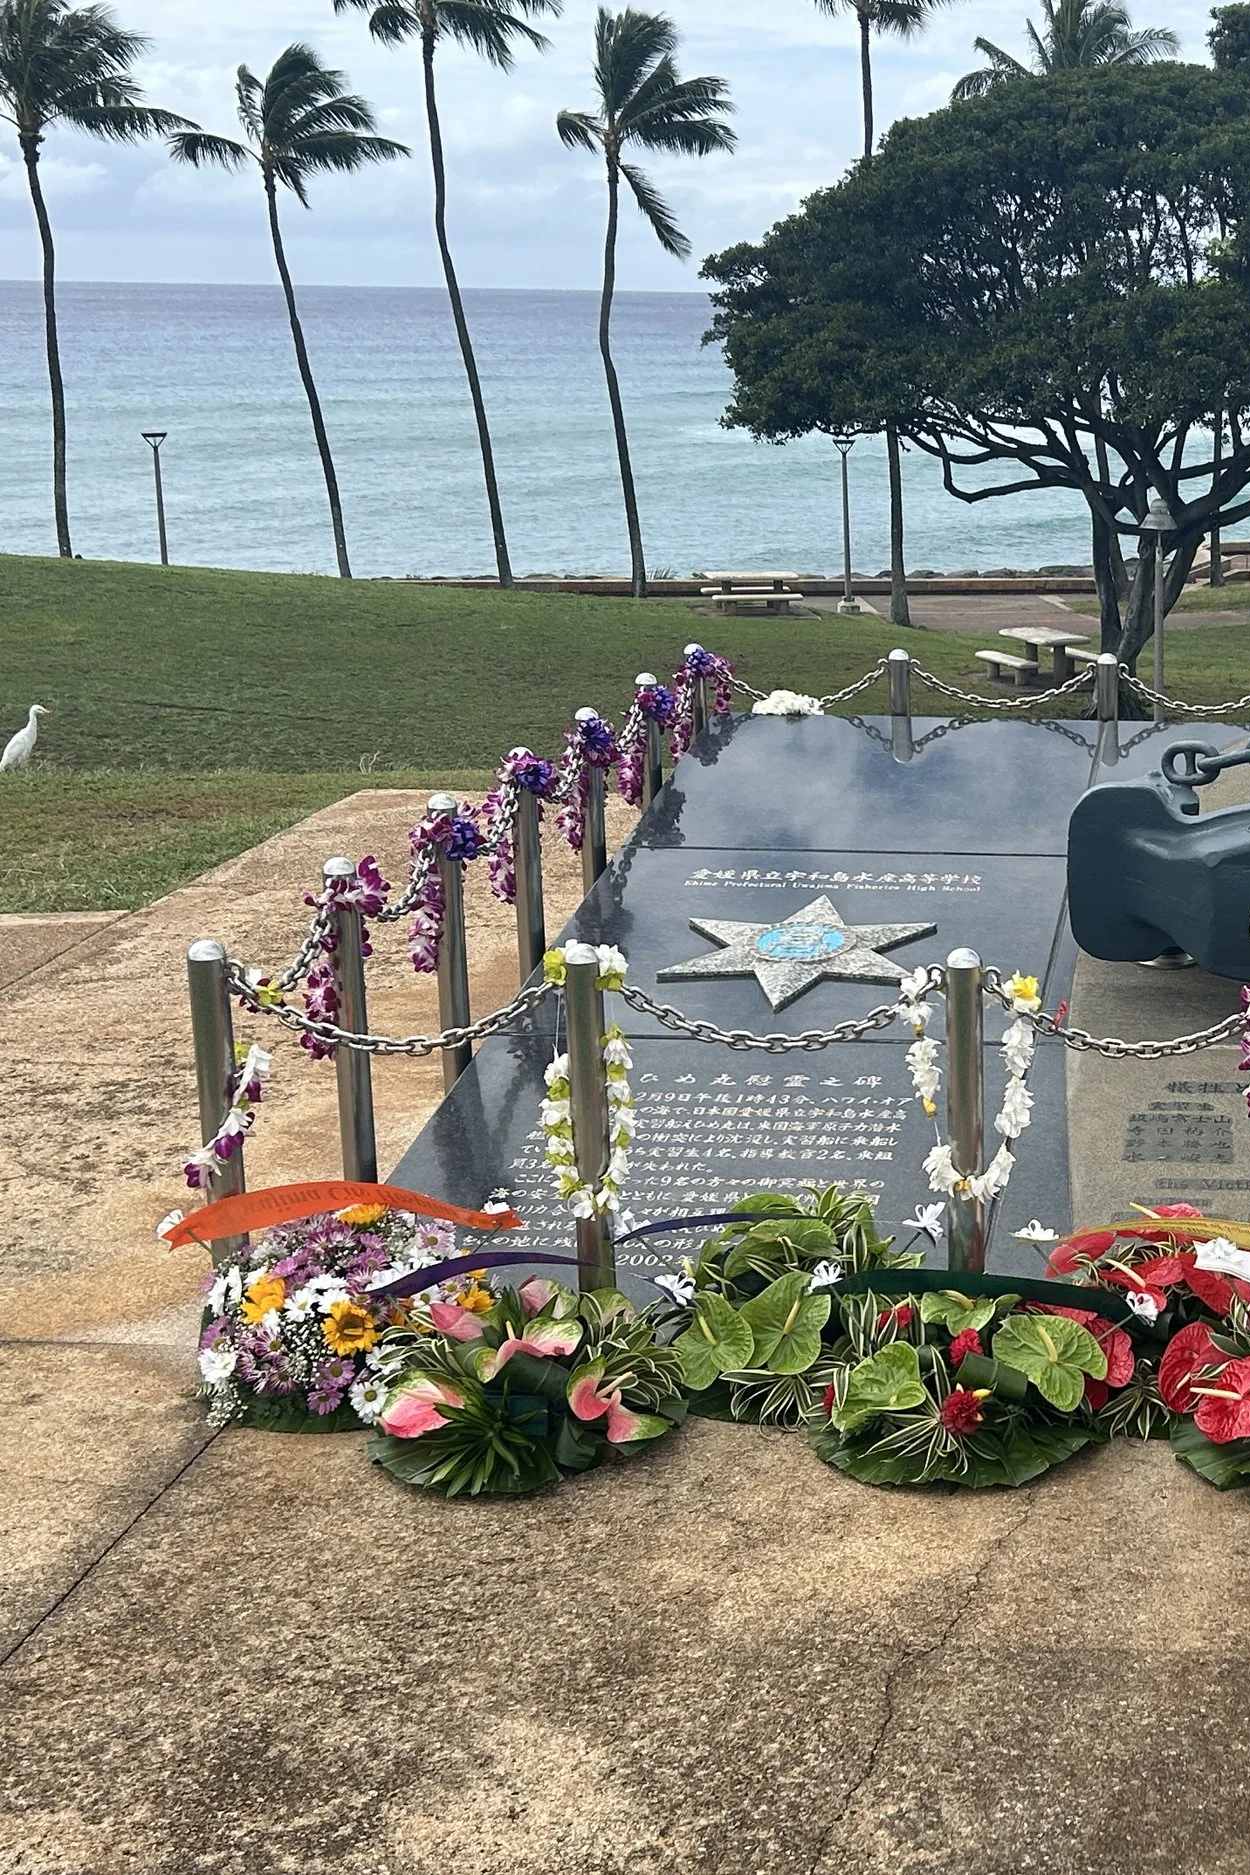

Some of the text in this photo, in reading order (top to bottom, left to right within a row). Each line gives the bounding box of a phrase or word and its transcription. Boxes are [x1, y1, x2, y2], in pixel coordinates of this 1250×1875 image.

[906, 884, 936, 892] High
[941, 885, 981, 893] School
[462, 1235, 577, 1248] をこの地に残
